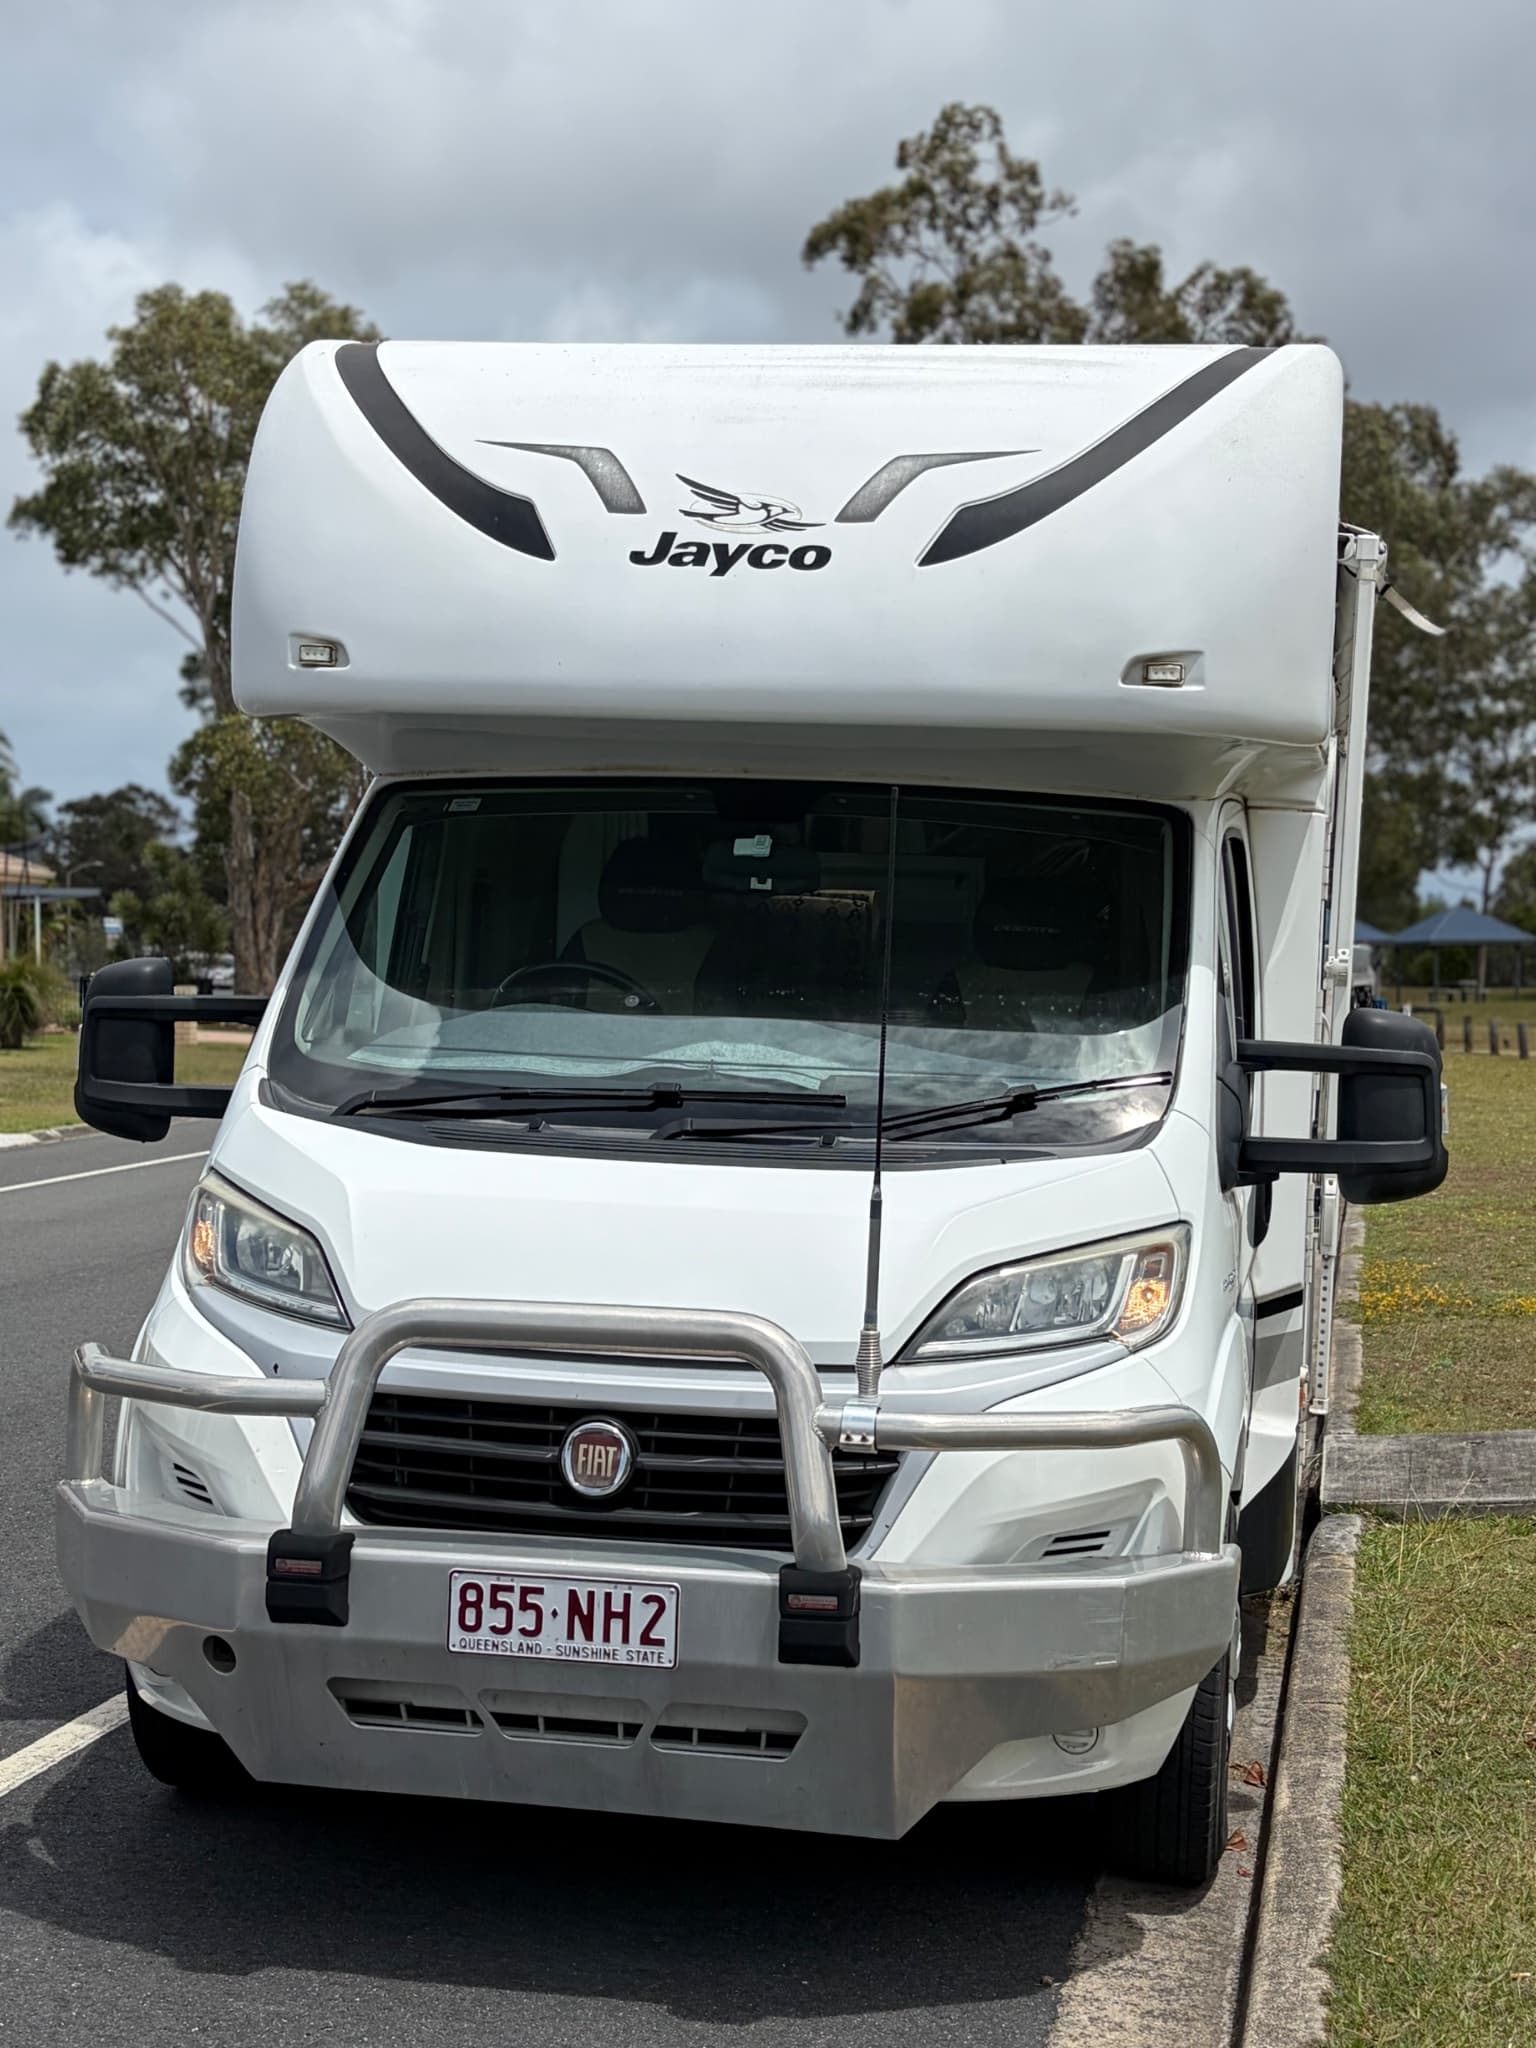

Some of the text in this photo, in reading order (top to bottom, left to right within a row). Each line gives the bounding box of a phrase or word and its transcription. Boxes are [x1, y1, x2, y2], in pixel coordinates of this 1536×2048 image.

[629, 531, 832, 577] Jayco
[577, 1443, 618, 1478] FIAT
[459, 1636, 543, 1655] QUEENSLAND
[556, 1644, 619, 1661] SUNSHINE
[626, 1649, 665, 1665] STATE
